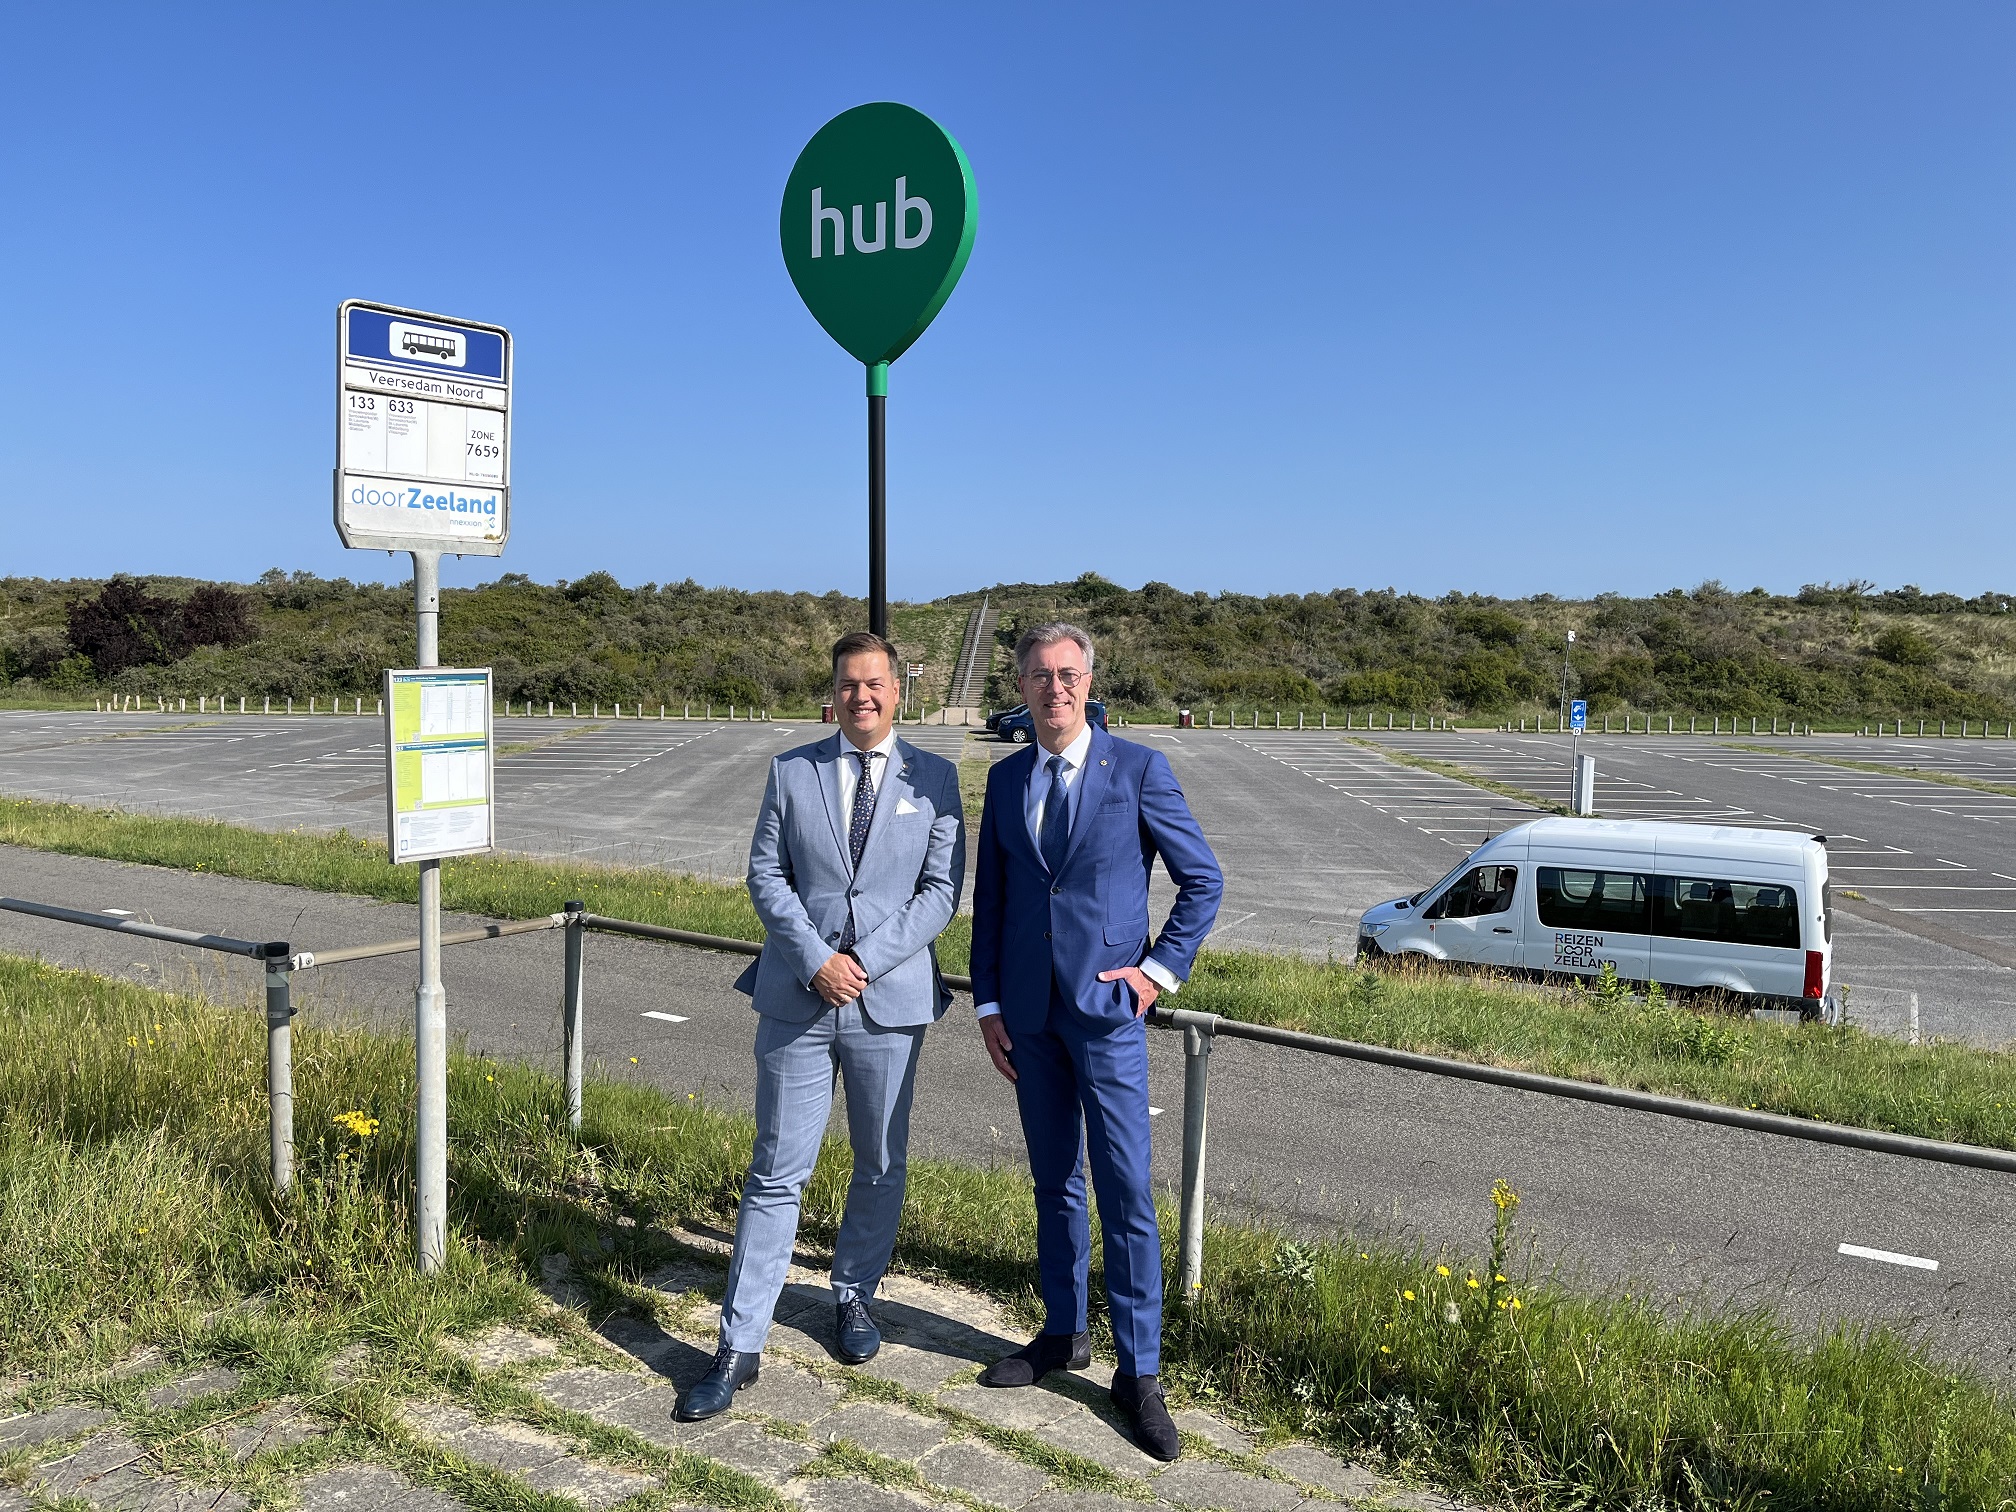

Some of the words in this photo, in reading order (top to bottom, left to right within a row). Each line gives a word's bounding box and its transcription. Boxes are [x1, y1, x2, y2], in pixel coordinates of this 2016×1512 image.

[812, 176, 933, 258] hub
[370, 372, 442, 393] Veersedam
[447, 384, 484, 399] Noord
[349, 395, 375, 410] 133
[389, 399, 414, 413] 633
[471, 430, 495, 441] ZONE
[467, 443, 499, 458] 7659
[450, 518, 482, 528] nnexxion
[1555, 933, 1604, 947] REIZEN
[1554, 944, 1593, 957] DOOR
[1554, 955, 1617, 971] ZEELAND
